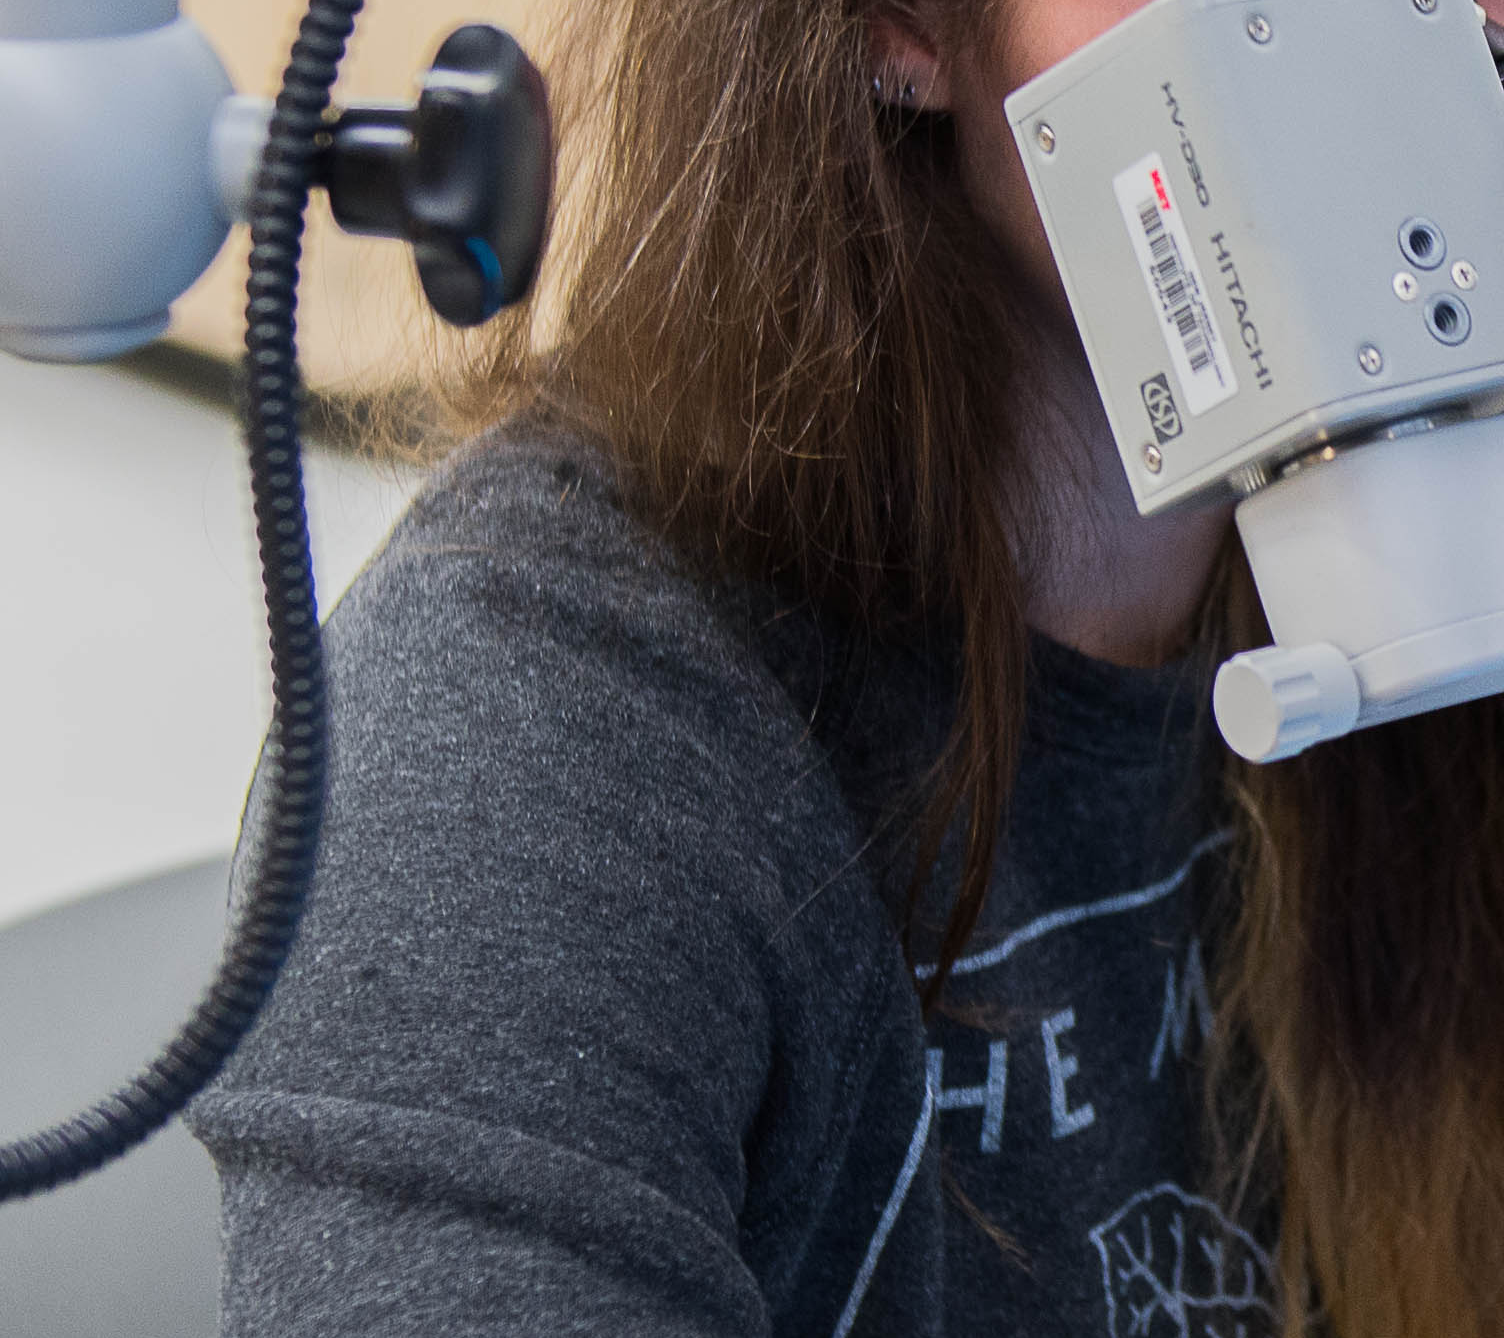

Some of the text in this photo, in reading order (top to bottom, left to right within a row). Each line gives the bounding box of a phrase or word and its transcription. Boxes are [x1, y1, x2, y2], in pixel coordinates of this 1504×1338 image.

[1209, 231, 1273, 391] HITACHI
[923, 937, 1216, 1154] HE M
